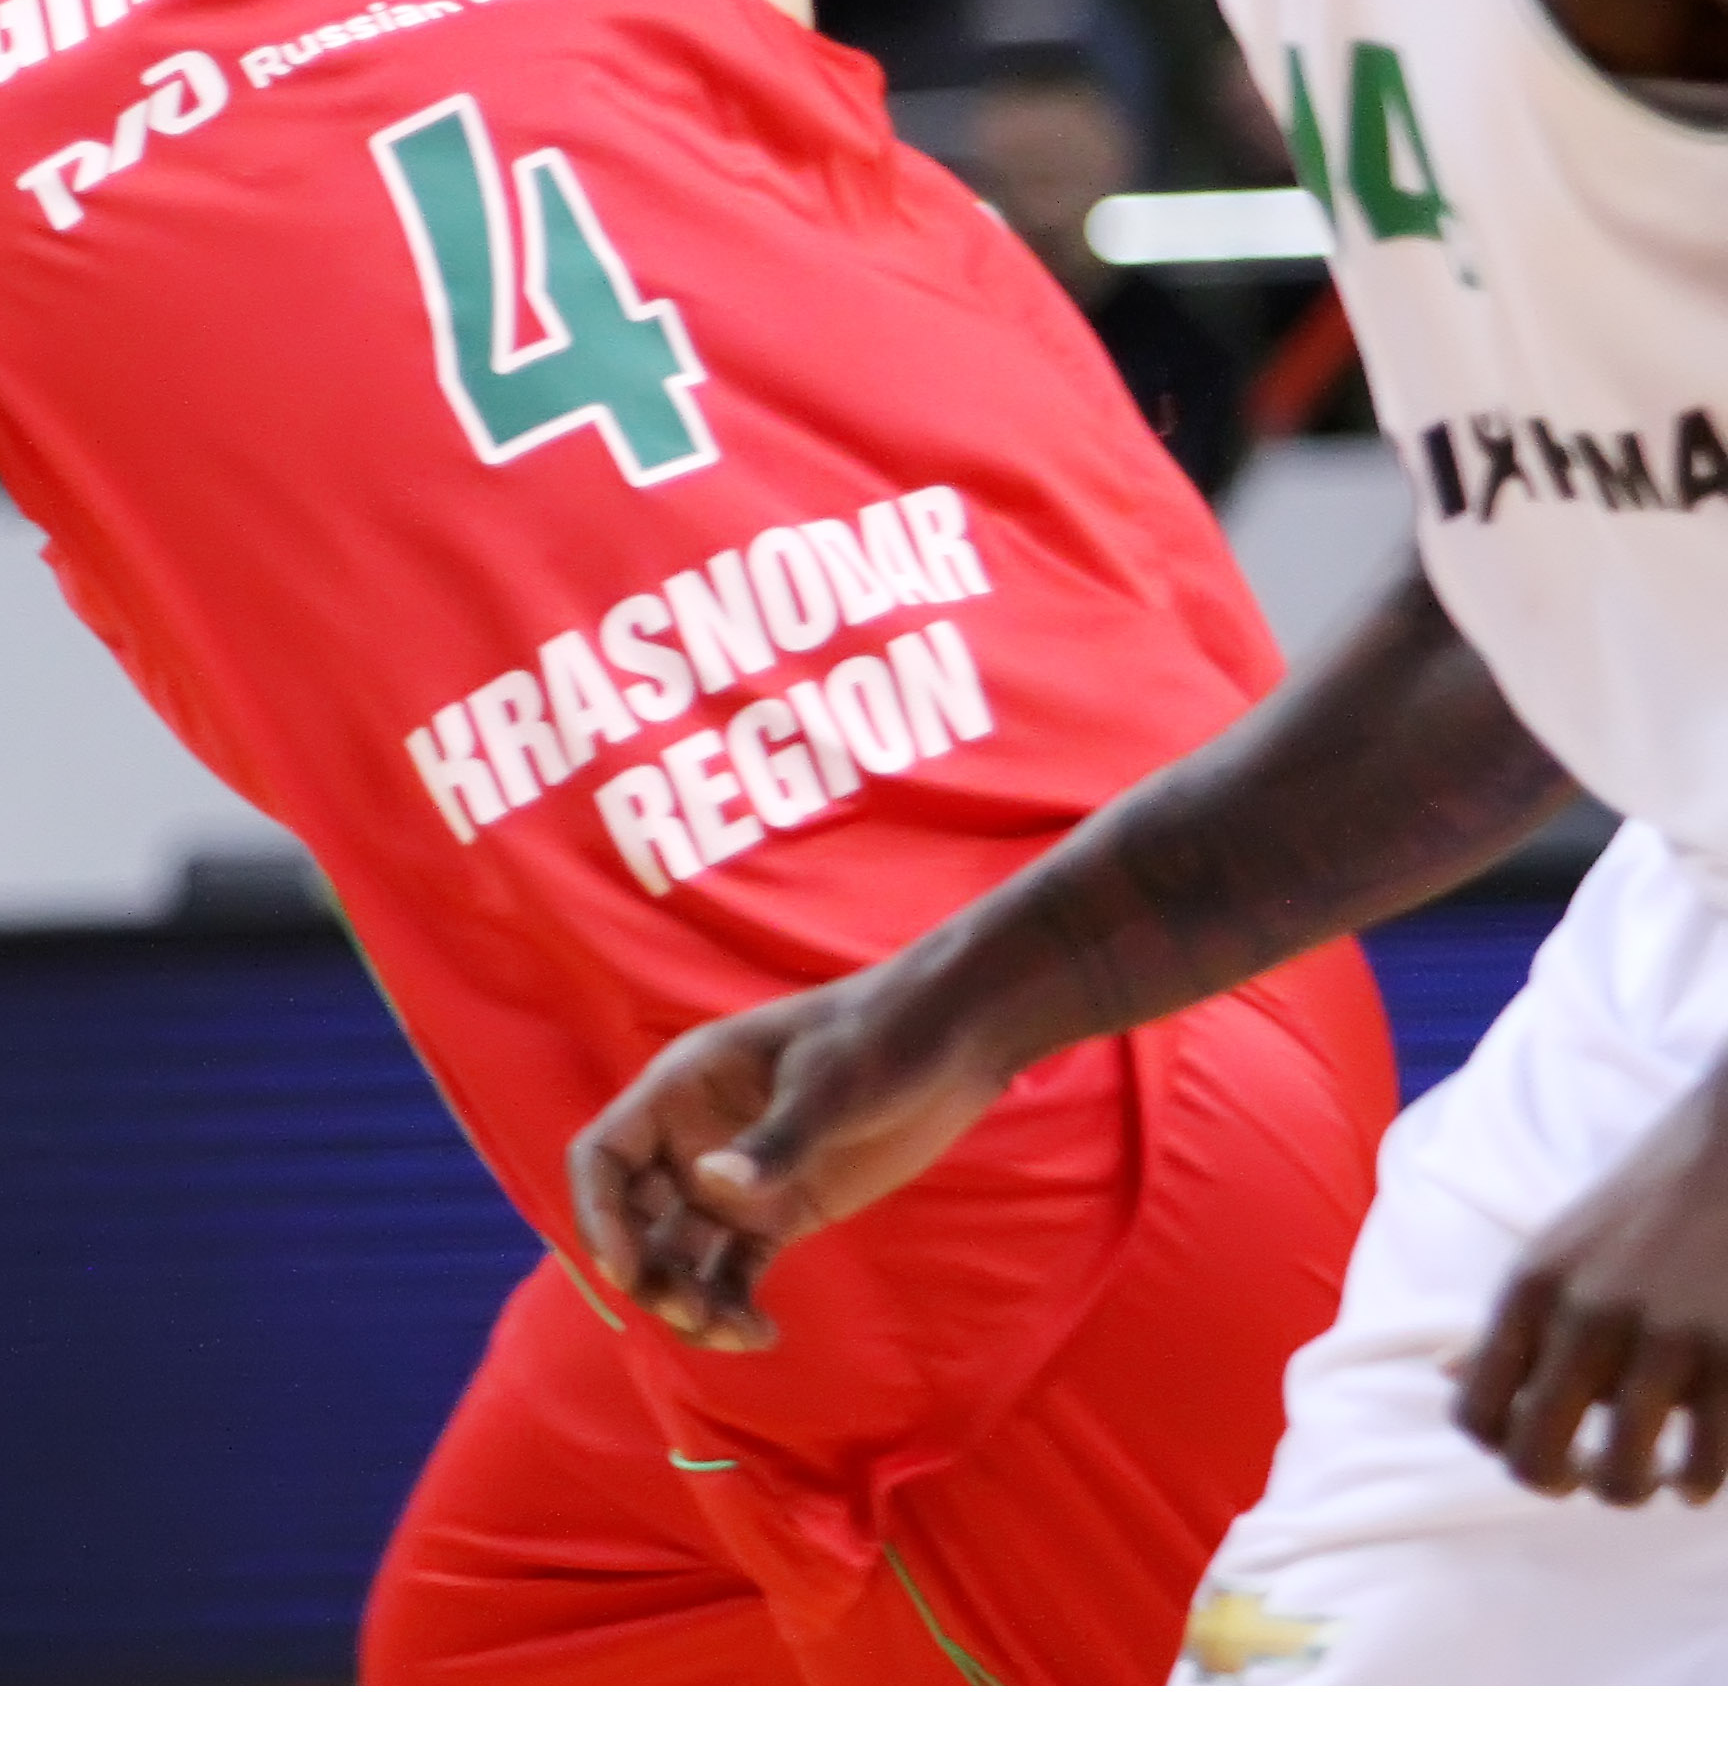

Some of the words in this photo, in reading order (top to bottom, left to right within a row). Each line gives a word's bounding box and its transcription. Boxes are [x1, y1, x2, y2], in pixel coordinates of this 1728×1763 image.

[239, 0, 464, 90] Russian
[370, 91, 720, 489] 4
[403, 484, 993, 847] KRASNODAR
[592, 619, 995, 898] REGION
